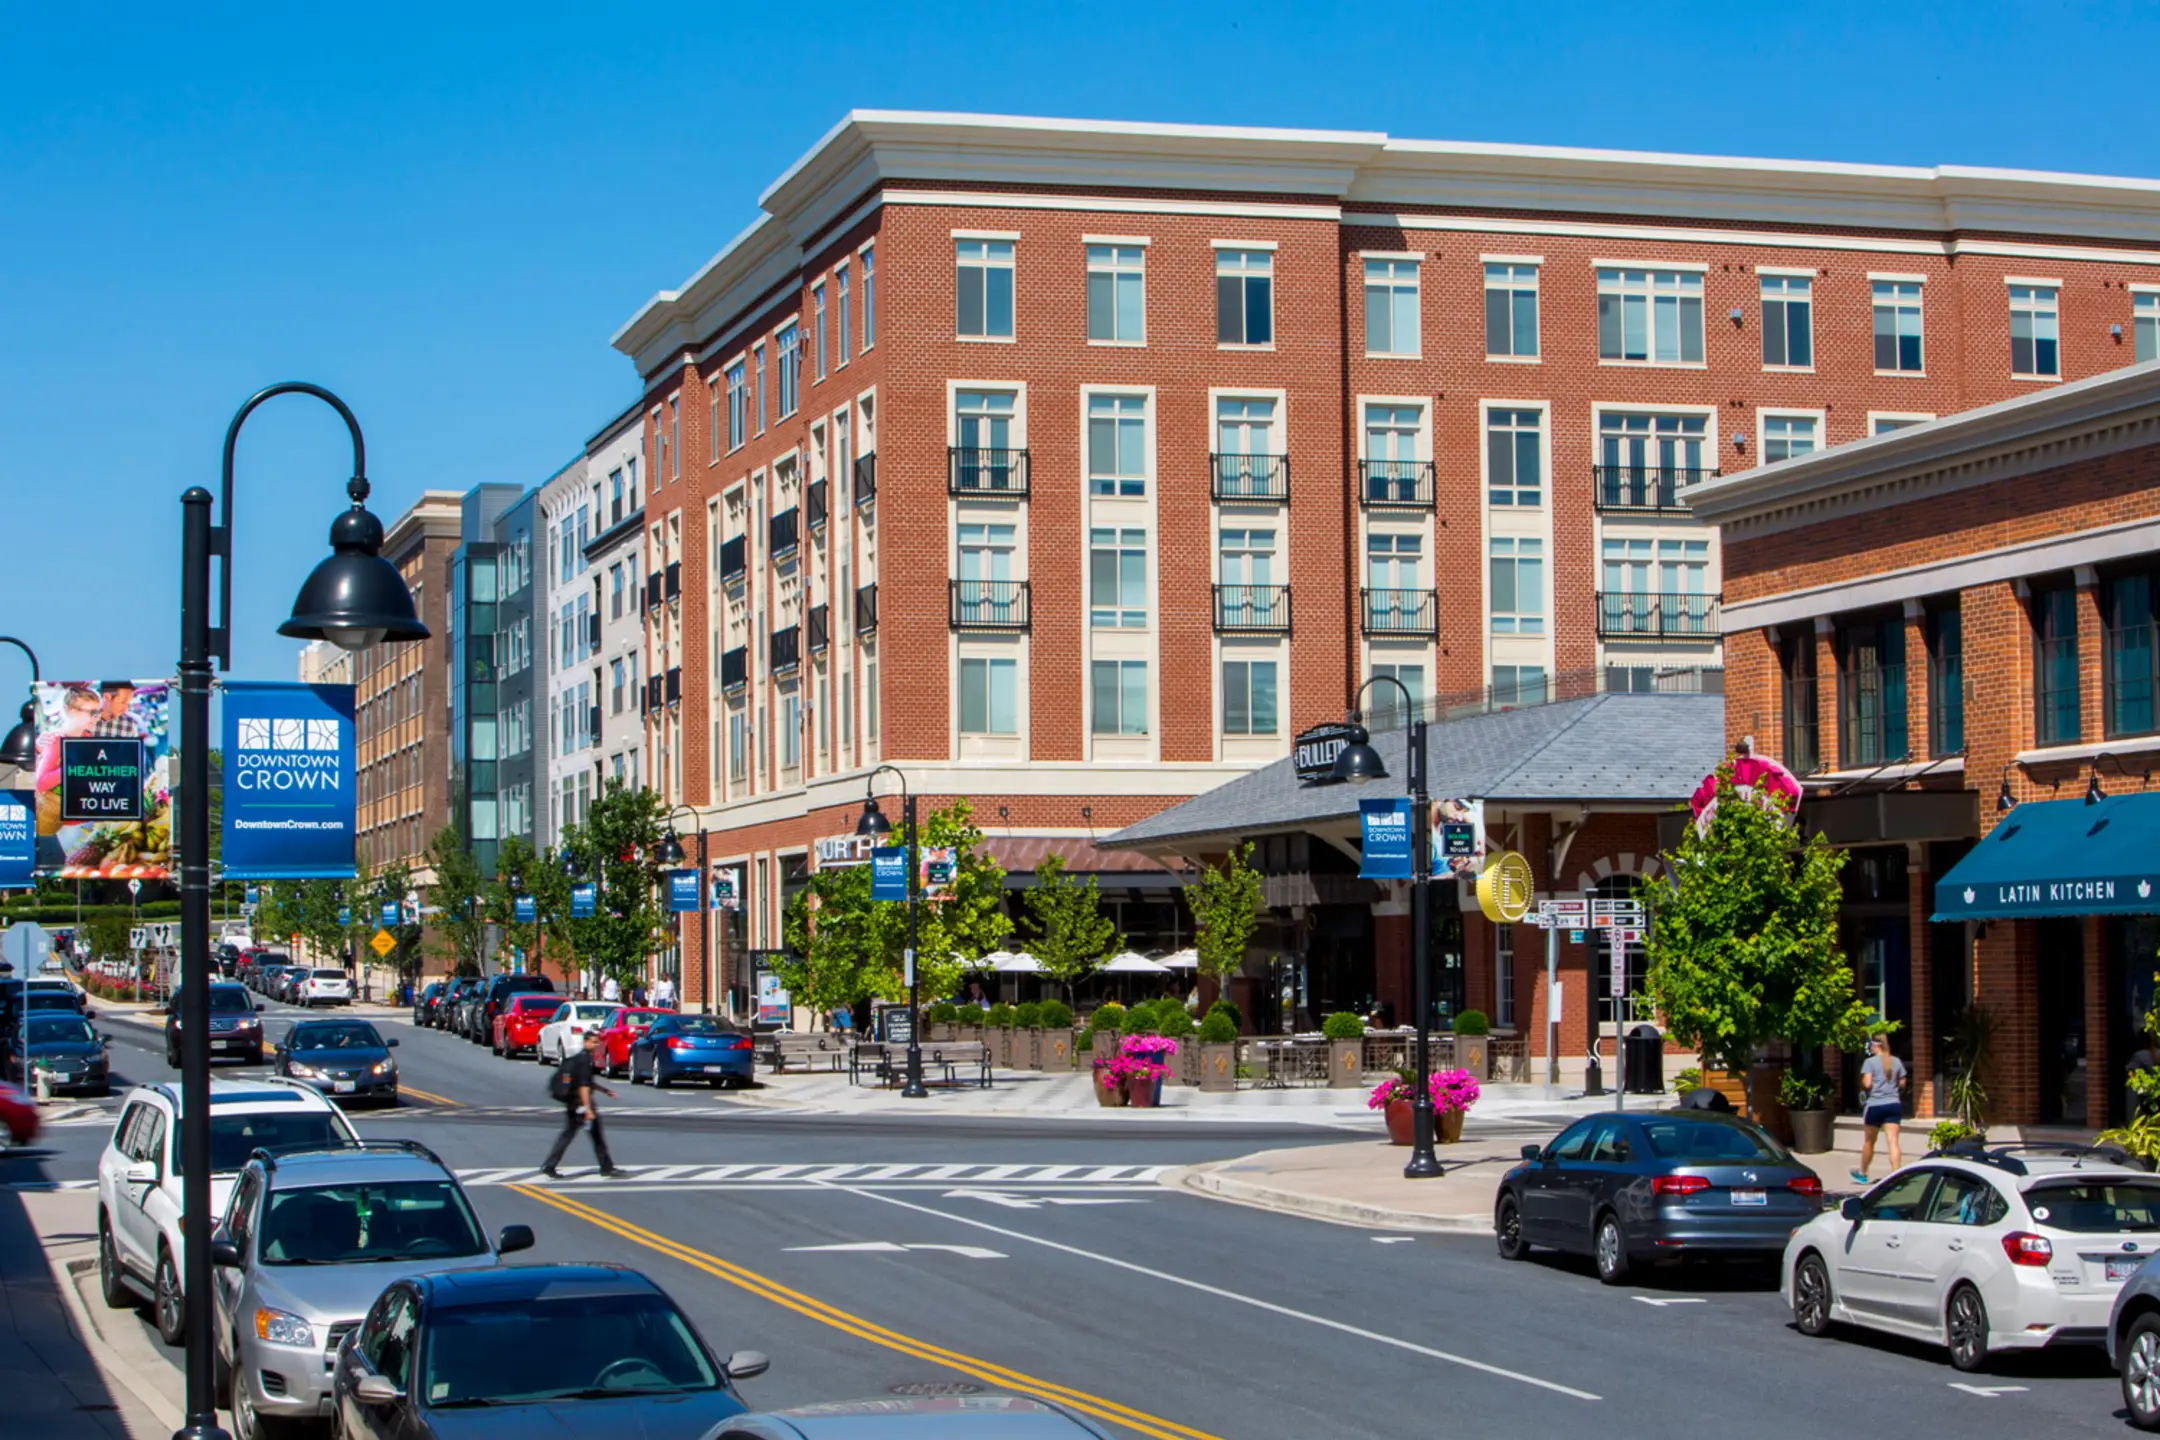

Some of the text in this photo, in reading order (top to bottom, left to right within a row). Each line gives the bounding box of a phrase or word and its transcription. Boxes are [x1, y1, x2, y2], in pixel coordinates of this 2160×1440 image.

[97, 749, 107, 761] A
[237, 754, 339, 768] DOWNTOWN
[67, 766, 138, 777] HEALTHIER
[237, 770, 339, 790] CROWN
[88, 782, 117, 793] WAY
[80, 798, 129, 810] TO LIVE
[235, 818, 343, 829] DowntownCrown.com
[1368, 833, 1407, 842] CROWN
[1999, 881, 2115, 903] LATIN KITCHEN
